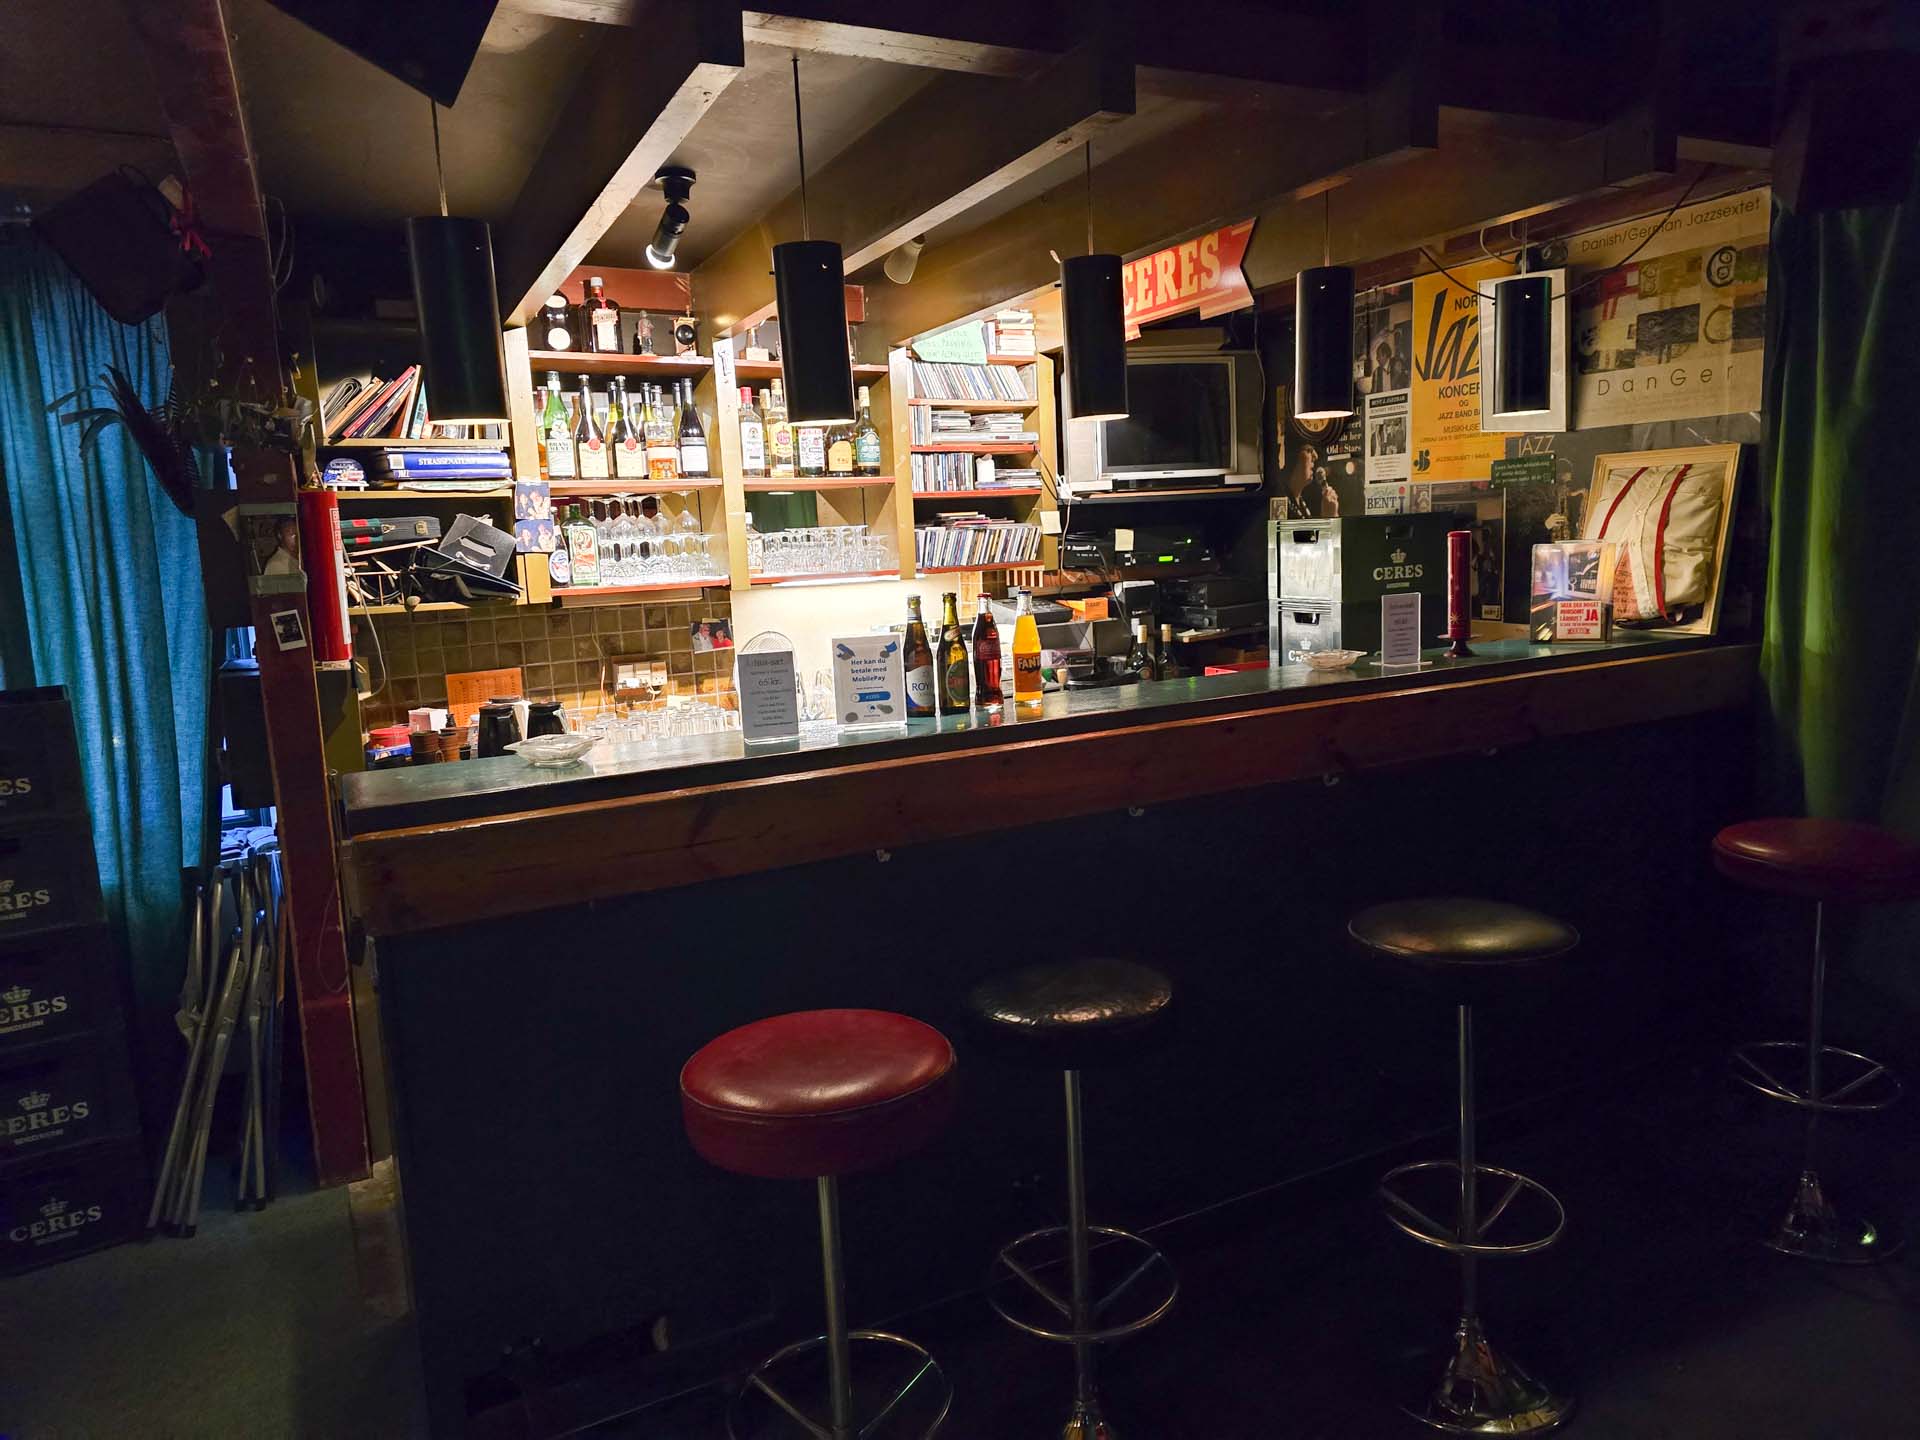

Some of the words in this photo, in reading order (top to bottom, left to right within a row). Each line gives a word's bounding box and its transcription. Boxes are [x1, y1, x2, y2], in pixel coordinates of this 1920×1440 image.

[1582, 216, 1682, 253] Danish/German
[1686, 197, 1760, 228] Jazzsextet
[1123, 231, 1220, 316] CERES
[1437, 411, 1453, 420] JAZZ
[1443, 422, 1480, 433] MUSIKHUSE
[1518, 434, 1555, 457] JAZZ
[1367, 496, 1396, 510] BENT
[1373, 564, 1423, 581] CERES
[1585, 608, 1599, 621] JA
[9, 1206, 102, 1242] CERES
